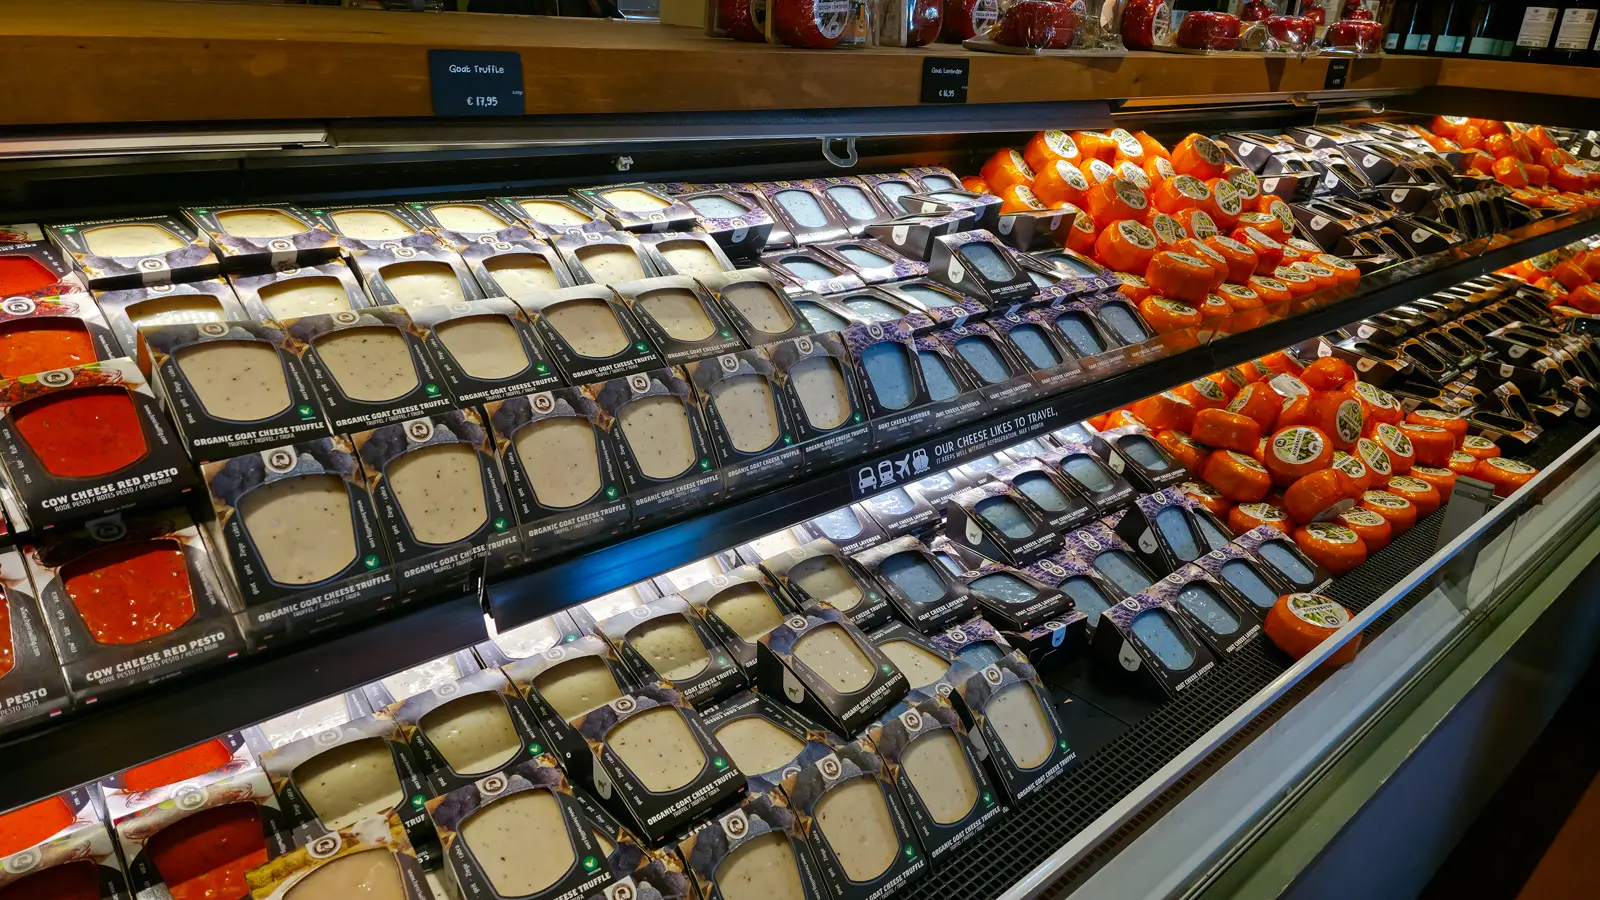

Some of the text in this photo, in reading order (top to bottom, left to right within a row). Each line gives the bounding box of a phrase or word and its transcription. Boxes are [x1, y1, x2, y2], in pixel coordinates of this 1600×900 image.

[449, 65, 504, 73] Goat Truffle
[467, 97, 498, 107] € 17,95
[572, 369, 598, 378] ORGANIC
[614, 360, 634, 369] CHEESE
[634, 355, 656, 364] TRUFFLE
[460, 392, 489, 401] ORGANIC
[508, 382, 531, 392] CHEESE
[532, 376, 558, 387] TRUFFLE
[336, 399, 450, 426] ORGANIC GOAT CHEESE TRUFFLE
[194, 422, 324, 446] ORGANIC GOAT CHEESE TRUFFLE
[935, 407, 1058, 456] OUR CHEESE LIKES TO TRAVEL,
[942, 455, 955, 463] KEEPS
[956, 450, 967, 458] WELL
[969, 444, 986, 454] WITHOUT
[987, 432, 1018, 448] REFRIGERATION,
[1019, 428, 1027, 436] MAX
[1030, 422, 1044, 431] MONTH
[42, 467, 178, 509] COW CHEESE RED PESTO
[55, 504, 71, 512] RODE
[73, 499, 91, 508] PESTO
[97, 492, 115, 501] ROTES
[116, 488, 134, 496] PESTO
[140, 482, 157, 490] PESTO
[636, 475, 718, 505] ORGANIC GOAT CHEESE TRUFFLE
[528, 504, 626, 536] ORGANIC GOAT CHEESE TRUFFLE
[404, 563, 438, 578] ORGANIC
[440, 556, 459, 566] GOAT
[487, 536, 517, 549] TRUFFLE
[258, 606, 298, 622] ORGANIC
[300, 596, 322, 607] GOAT
[324, 586, 355, 601] CHEESE
[356, 574, 390, 590] TRUFFLE
[918, 595, 968, 621] GOAT CHEESE LAVENDER
[1027, 602, 1042, 612] CHEESE
[1042, 594, 1063, 605] LAVENDER
[86, 632, 226, 682] COW CHEESE RED PESTO
[99, 644, 218, 684] RODE PESTO ROTES PESTO PESTO ROJO
[6, 688, 47, 705] PESTO
[684, 668, 738, 696] GOAT CHEESE TRUFFLE
[842, 673, 903, 721] ORGANIC GOAT CHEESE TRUFFLE
[647, 769, 738, 826] ORGANIC GOAT CHEESE TRUFFLE
[932, 806, 1000, 858] ORGANIC GOAT CHEESE TRUFFLE
[578, 872, 611, 891] TRUFFLE
[883, 875, 903, 892] CHEESE
[902, 860, 924, 880] TRUFFLE
